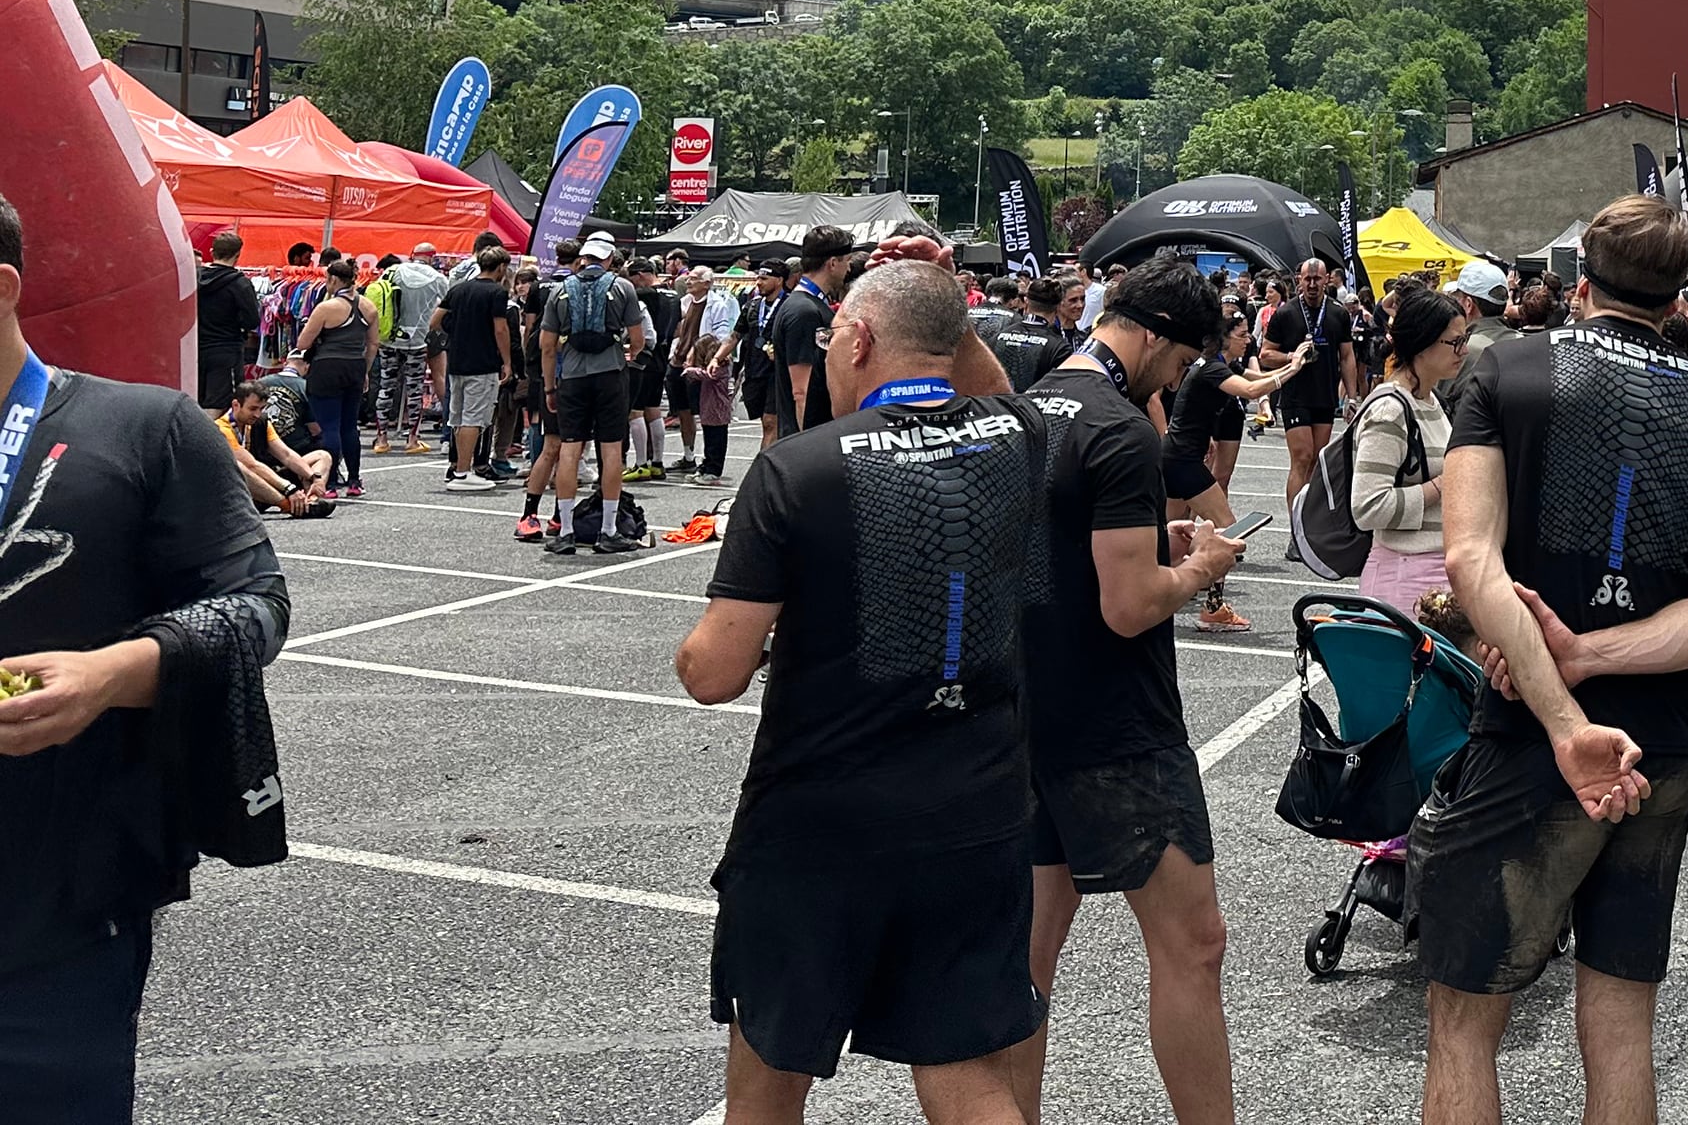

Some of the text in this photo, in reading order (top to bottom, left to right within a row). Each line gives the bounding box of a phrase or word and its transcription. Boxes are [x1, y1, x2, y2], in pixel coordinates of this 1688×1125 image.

[674, 136, 709, 149] River
[561, 183, 591, 196] Venda
[671, 177, 707, 188] centre
[342, 186, 365, 206] OTSO
[559, 192, 592, 204] Lloguer
[1209, 198, 1254, 208] OPTIMUM
[553, 207, 580, 219] Venta
[1009, 179, 1031, 251] NUTRITION
[1207, 204, 1259, 214] NUTRITION
[999, 190, 1018, 253] OPTIMUM
[740, 220, 898, 245] SPATAN
[1423, 259, 1447, 269] C4
[967, 308, 1015, 318] NISHER
[997, 332, 1049, 347] FINISHER
[1605, 351, 1646, 371] SPARTAN
[890, 384, 931, 397] SPARTAN
[839, 414, 1024, 455] FINISHER
[909, 447, 954, 464] SPARTAN
[1608, 463, 1636, 571] BE UNBREAKABLE
[943, 570, 966, 680] BE UNBREAKABLE
